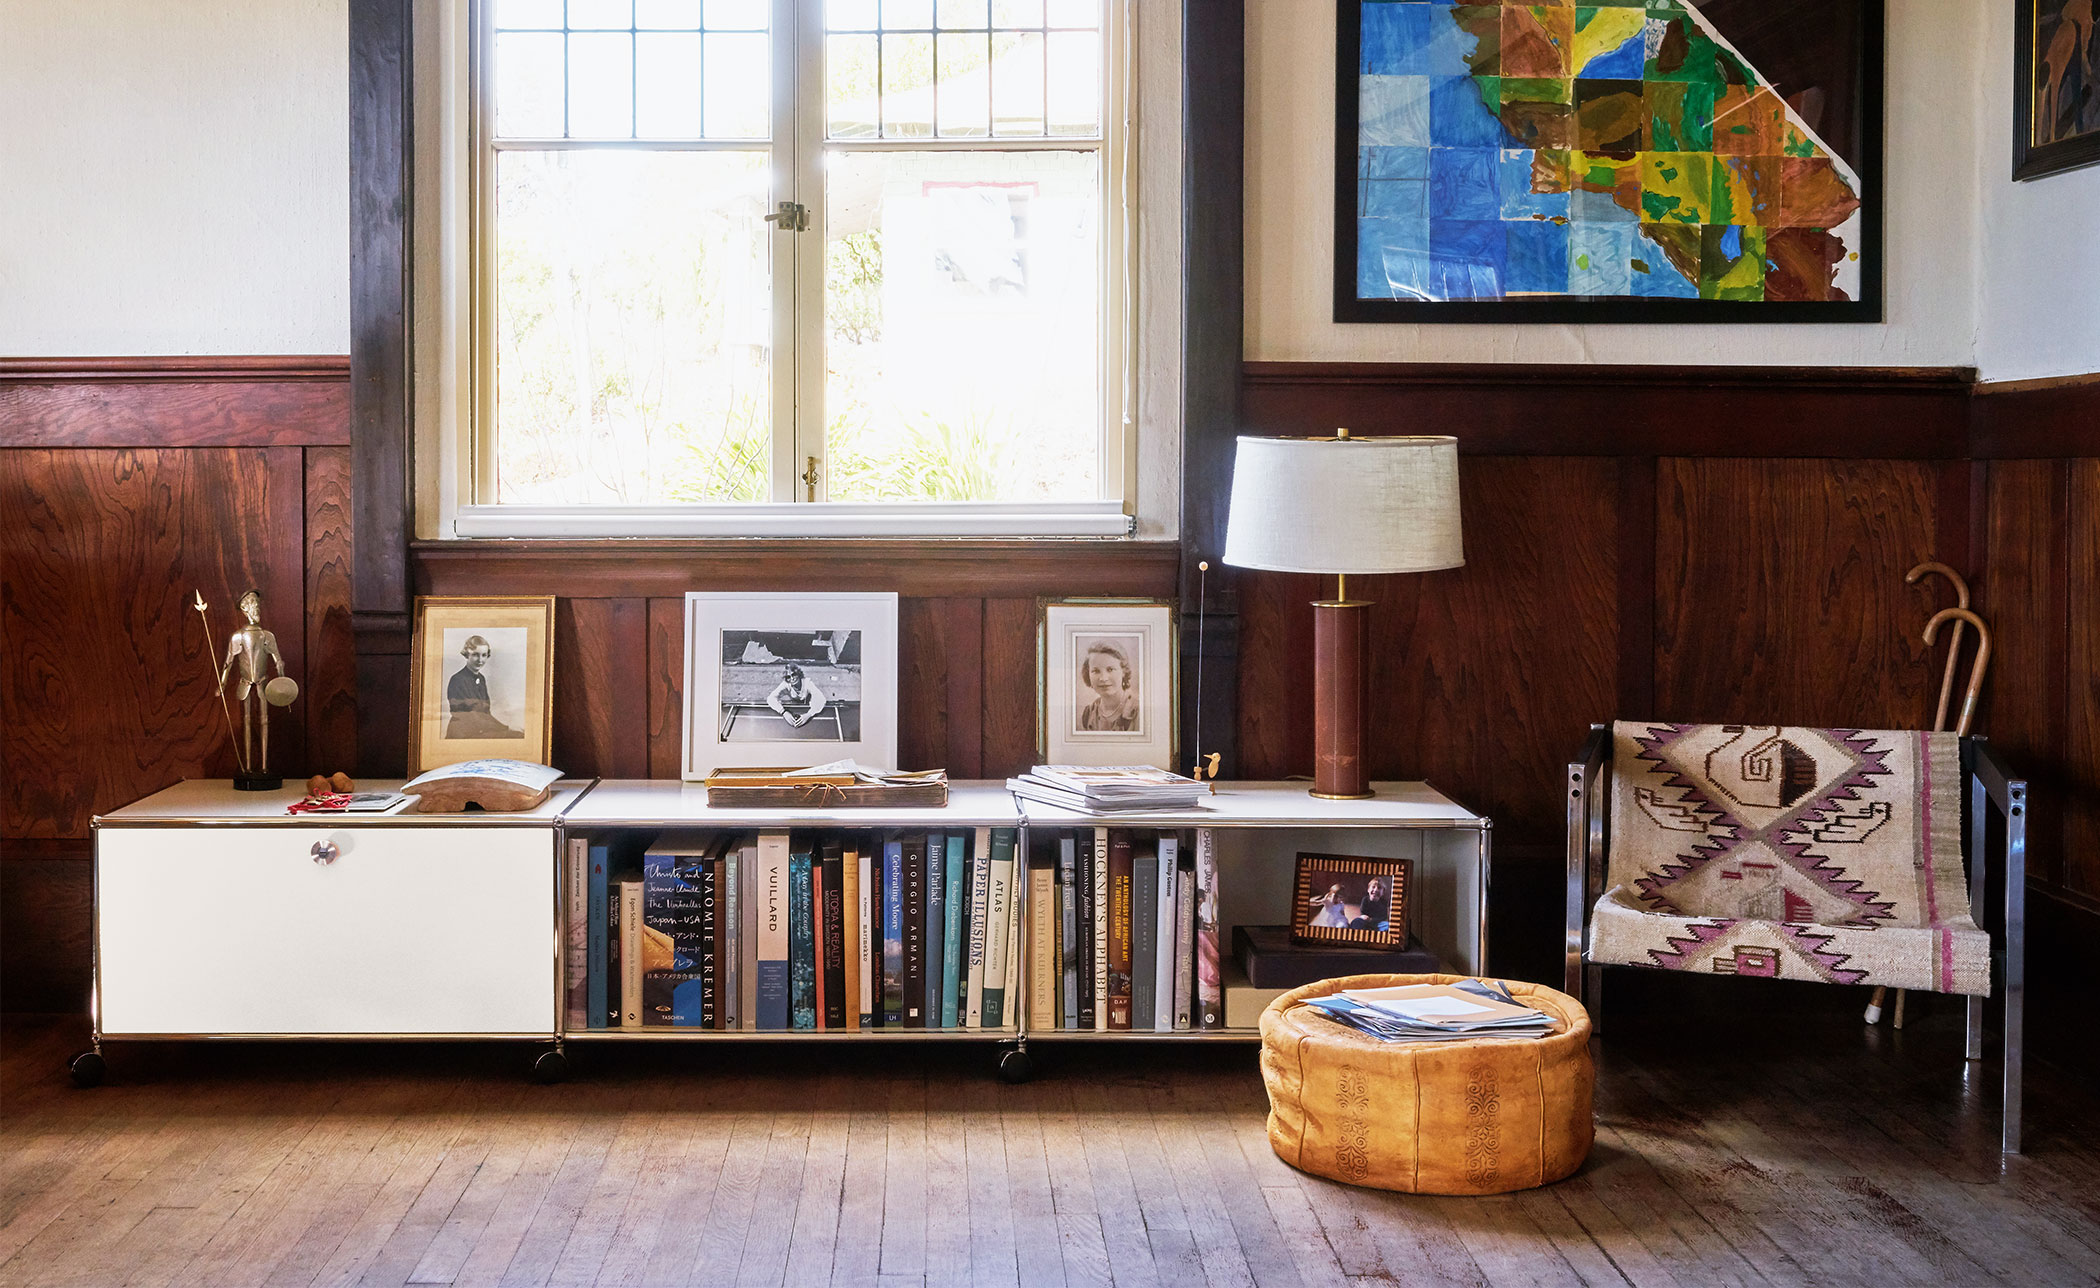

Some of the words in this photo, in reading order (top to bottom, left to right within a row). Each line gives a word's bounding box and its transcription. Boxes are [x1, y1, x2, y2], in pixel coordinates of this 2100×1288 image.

[929, 844, 942, 870] Jaime
[1203, 830, 1211, 866] CHARLES
[684, 868, 700, 878] and
[727, 862, 738, 896] Beyond
[801, 877, 810, 891] Day
[891, 854, 900, 902] Celebrating
[975, 857, 987, 897] PAPER
[1063, 861, 1072, 887] Lucian
[1096, 838, 1106, 923] HOCKNEY'S
[1122, 875, 1129, 883] AN
[1182, 877, 1190, 897] Andy
[1204, 868, 1212, 894] JAMES
[704, 872, 714, 942] NAOMIE
[769, 866, 778, 932] VUILLARD
[830, 889, 839, 922] UTOPIA
[951, 880, 959, 904] Richard
[994, 879, 1004, 913] ATLAS
[1064, 887, 1073, 910] Freud
[1081, 894, 1091, 919] fashion
[728, 896, 737, 930] Reason
[801, 912, 811, 941] Country
[831, 923, 839, 931] &
[892, 903, 900, 930] Moore
[950, 905, 959, 941] Diebenkorn
[1122, 916, 1129, 925] OF
[1181, 897, 1190, 945] Goldsworthy
[971, 901, 985, 966] ILLUSIONS
[1038, 938, 1045, 951] AT
[831, 932, 840, 969] REALITY
[1096, 927, 1106, 1005] ALPHABET
[704, 954, 714, 1022] KREMER
